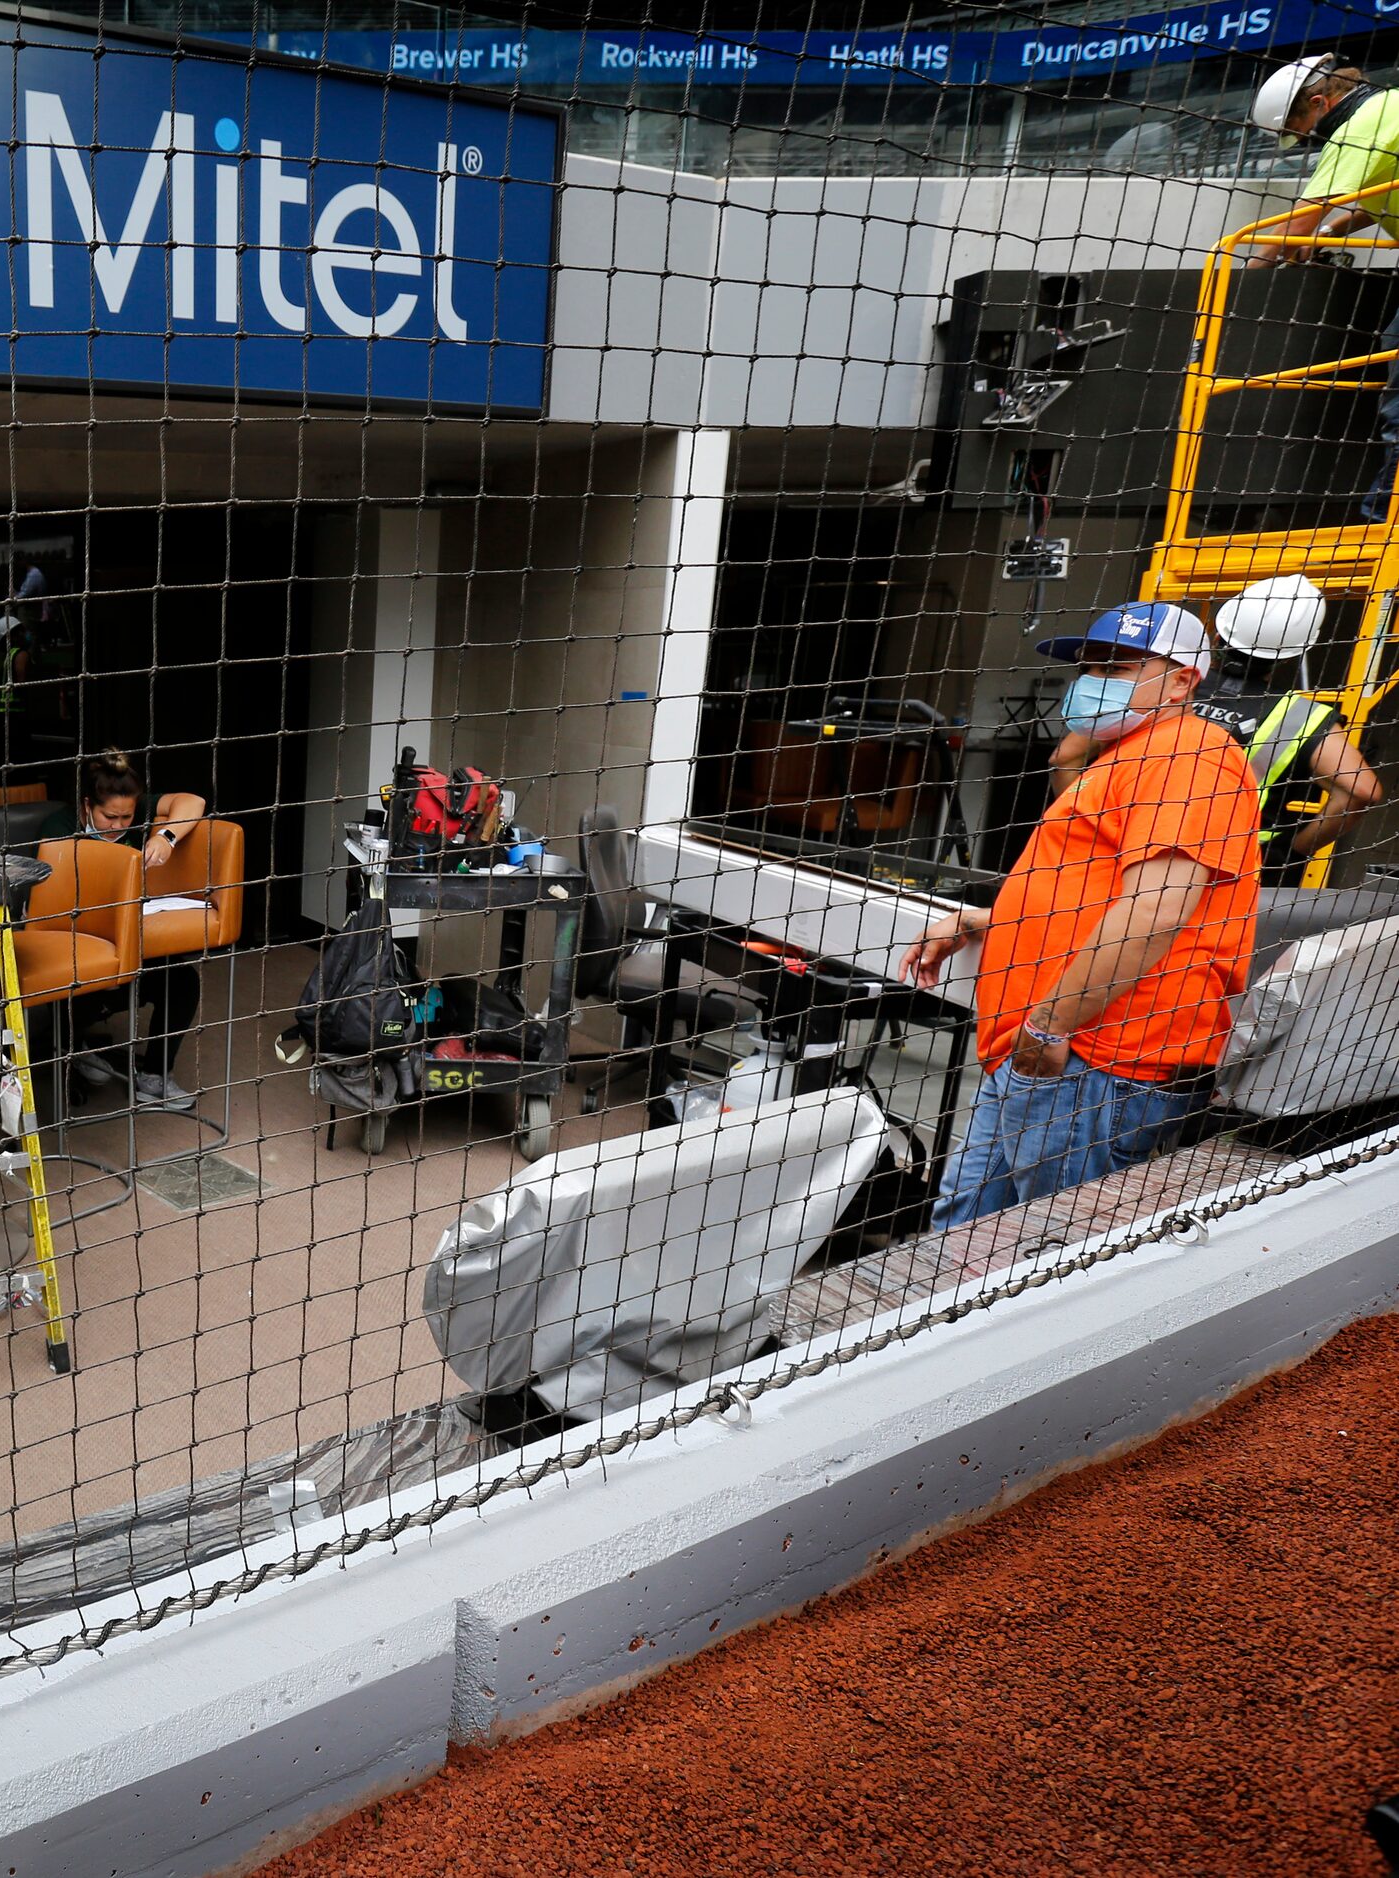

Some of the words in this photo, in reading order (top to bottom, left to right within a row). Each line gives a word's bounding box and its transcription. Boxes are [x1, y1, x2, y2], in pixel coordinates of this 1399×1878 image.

[1022, 20, 1209, 67] Duncanville
[1219, 7, 1271, 39] HS
[392, 43, 483, 69] Brewer
[491, 43, 528, 69] HS
[602, 42, 713, 69] Rockwall
[721, 44, 759, 70] HS
[829, 44, 904, 69] Heath
[912, 44, 949, 70] HS
